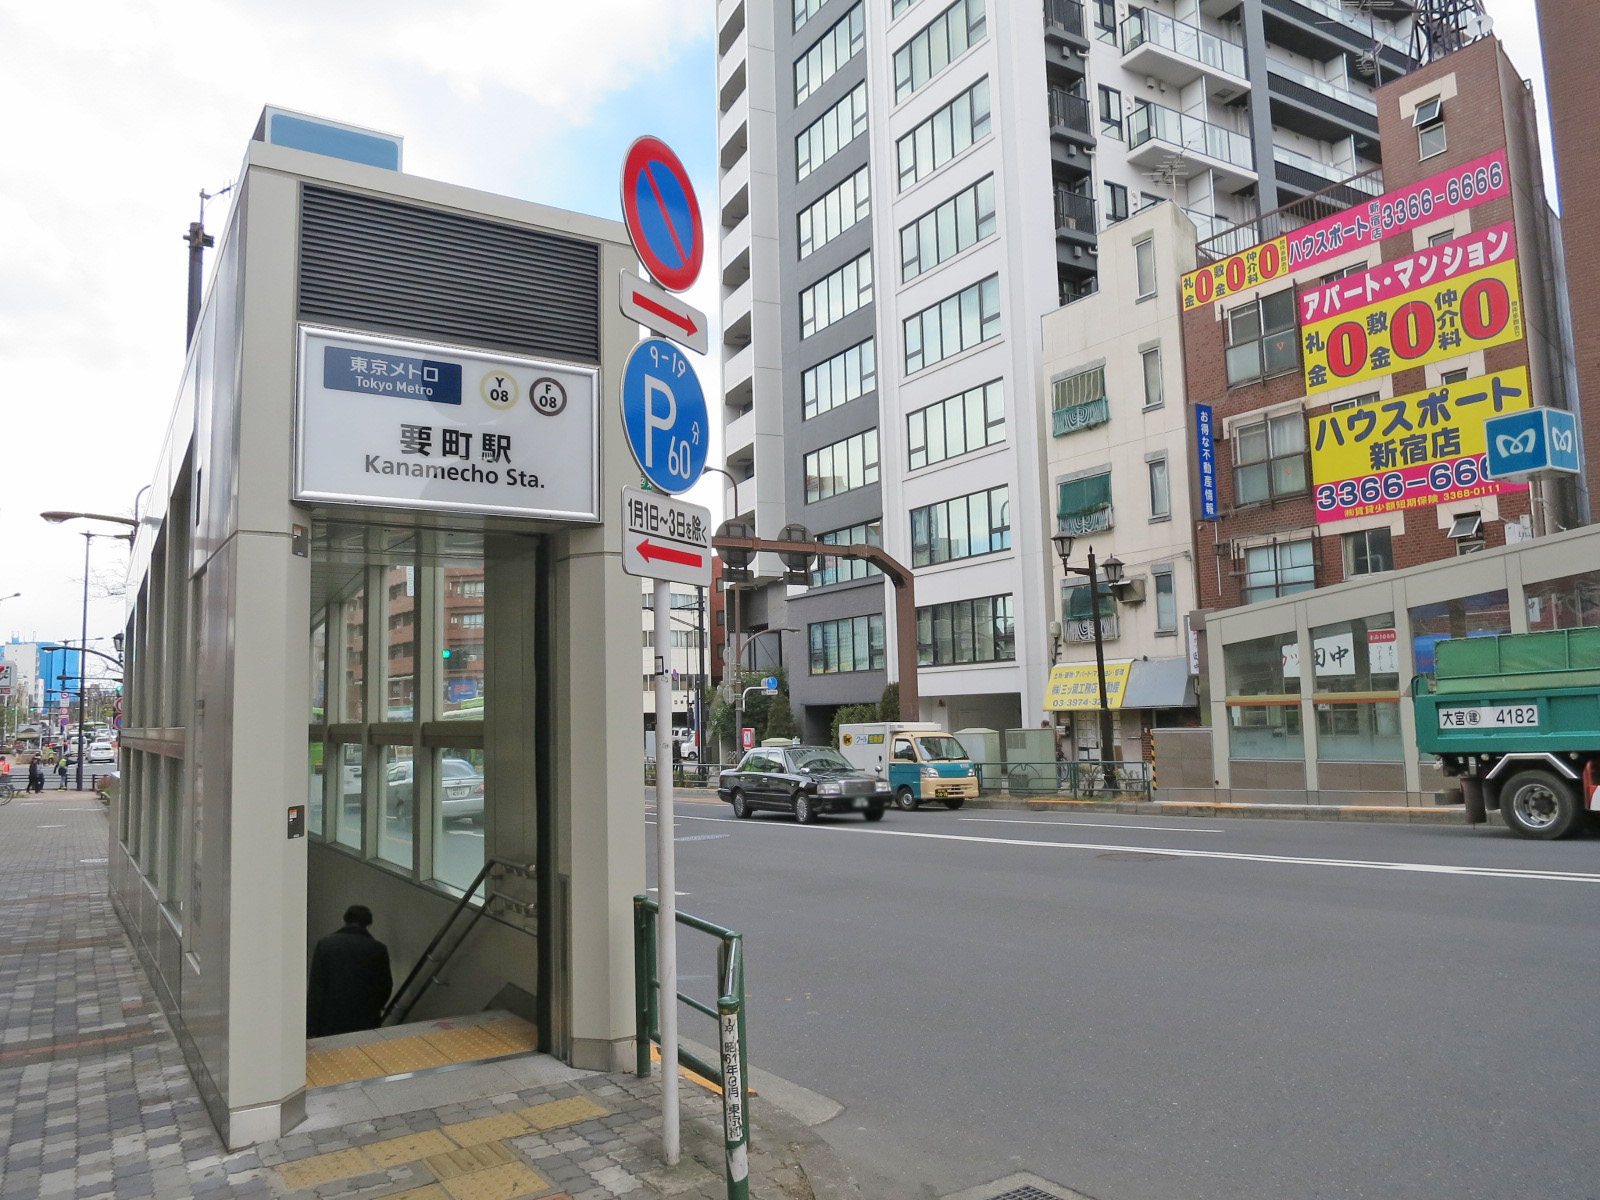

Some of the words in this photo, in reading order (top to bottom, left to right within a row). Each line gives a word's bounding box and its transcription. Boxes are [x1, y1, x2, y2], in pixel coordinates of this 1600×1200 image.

[1288, 214, 1370, 267] ハウスポート
[1369, 200, 1383, 240] 新宿店
[1382, 161, 1504, 230] 3366-6666
[1303, 229, 1510, 320] アパート・マンション
[350, 356, 439, 383] 東京メトロ
[650, 346, 686, 379] 9-19
[355, 375, 394, 392] Tokyo
[396, 381, 434, 397] Metro
[490, 389, 509, 403] 08
[495, 377, 505, 388] Y
[545, 384, 552, 395] F
[539, 396, 558, 409] 08
[1315, 376, 1522, 451] ハウスポート
[644, 374, 677, 468] P
[400, 423, 512, 465] 要町駅
[1369, 427, 1462, 471] 新宿店
[364, 454, 499, 485] Kanamecho
[506, 468, 546, 489] Sta.
[1200, 411, 1214, 515] お得な不動産情報
[1443, 484, 1501, 502] 3368-0111
[1496, 707, 1536, 724] 4182
